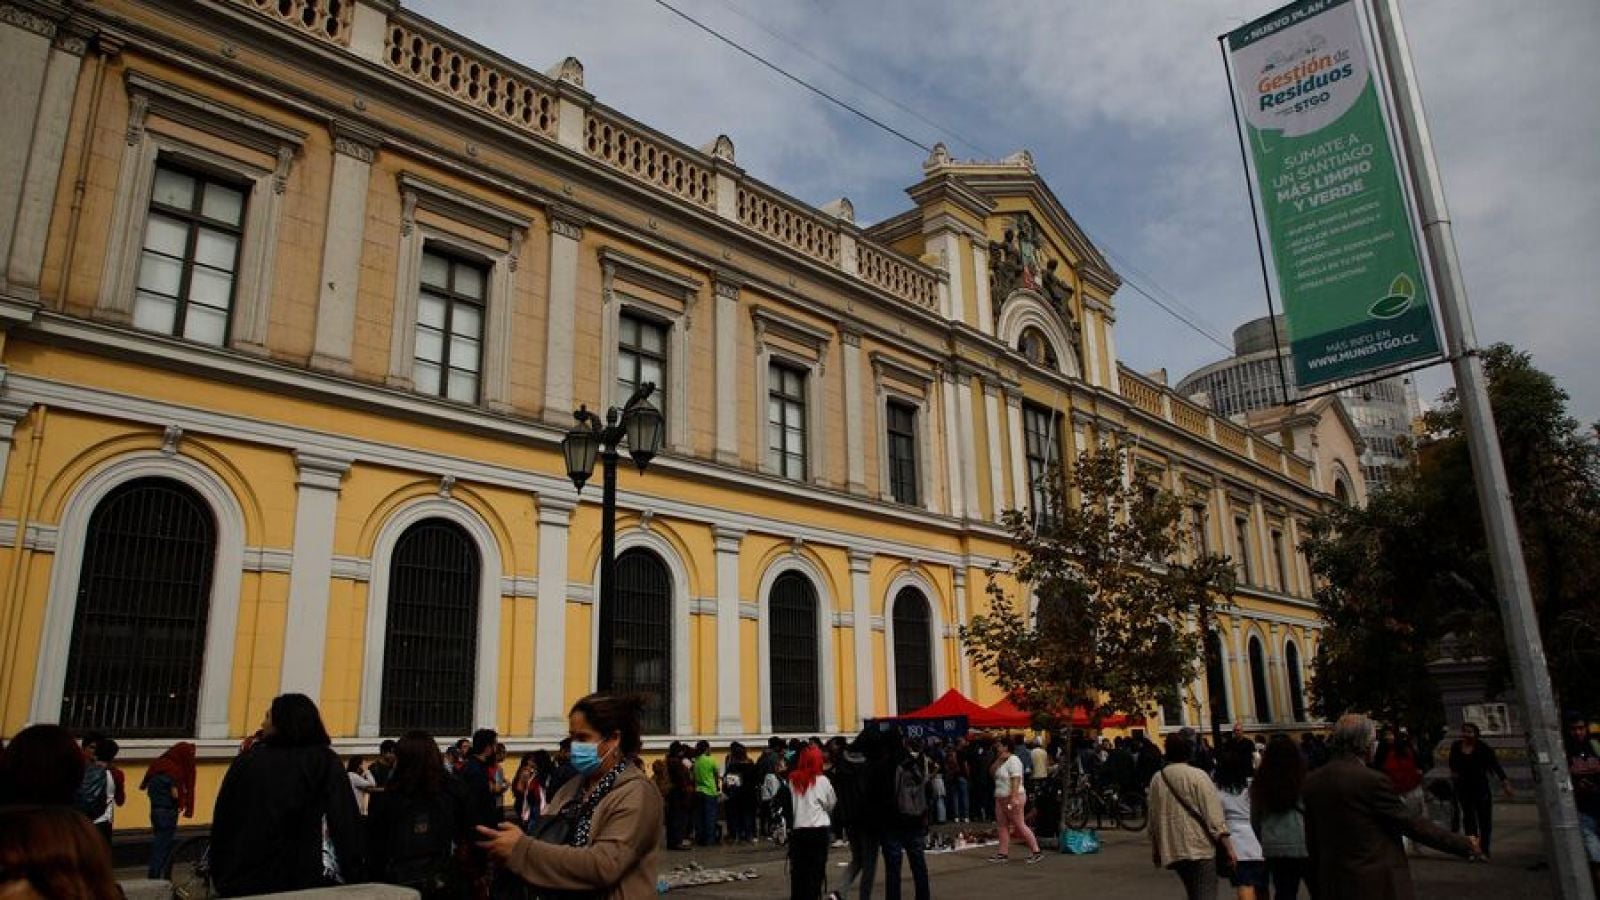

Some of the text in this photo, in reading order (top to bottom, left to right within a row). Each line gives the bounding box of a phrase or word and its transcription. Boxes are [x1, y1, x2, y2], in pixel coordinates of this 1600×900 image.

[1250, 16, 1290, 39] NUEVO
[1258, 54, 1333, 93] Gestión
[1259, 63, 1352, 111] Residuos
[1294, 91, 1330, 112] STGO
[1348, 132, 1359, 146] A
[1272, 143, 1373, 188] UN SANTIAGO
[1314, 160, 1371, 190] LIMPIO
[1293, 179, 1364, 212] Y VERDE
